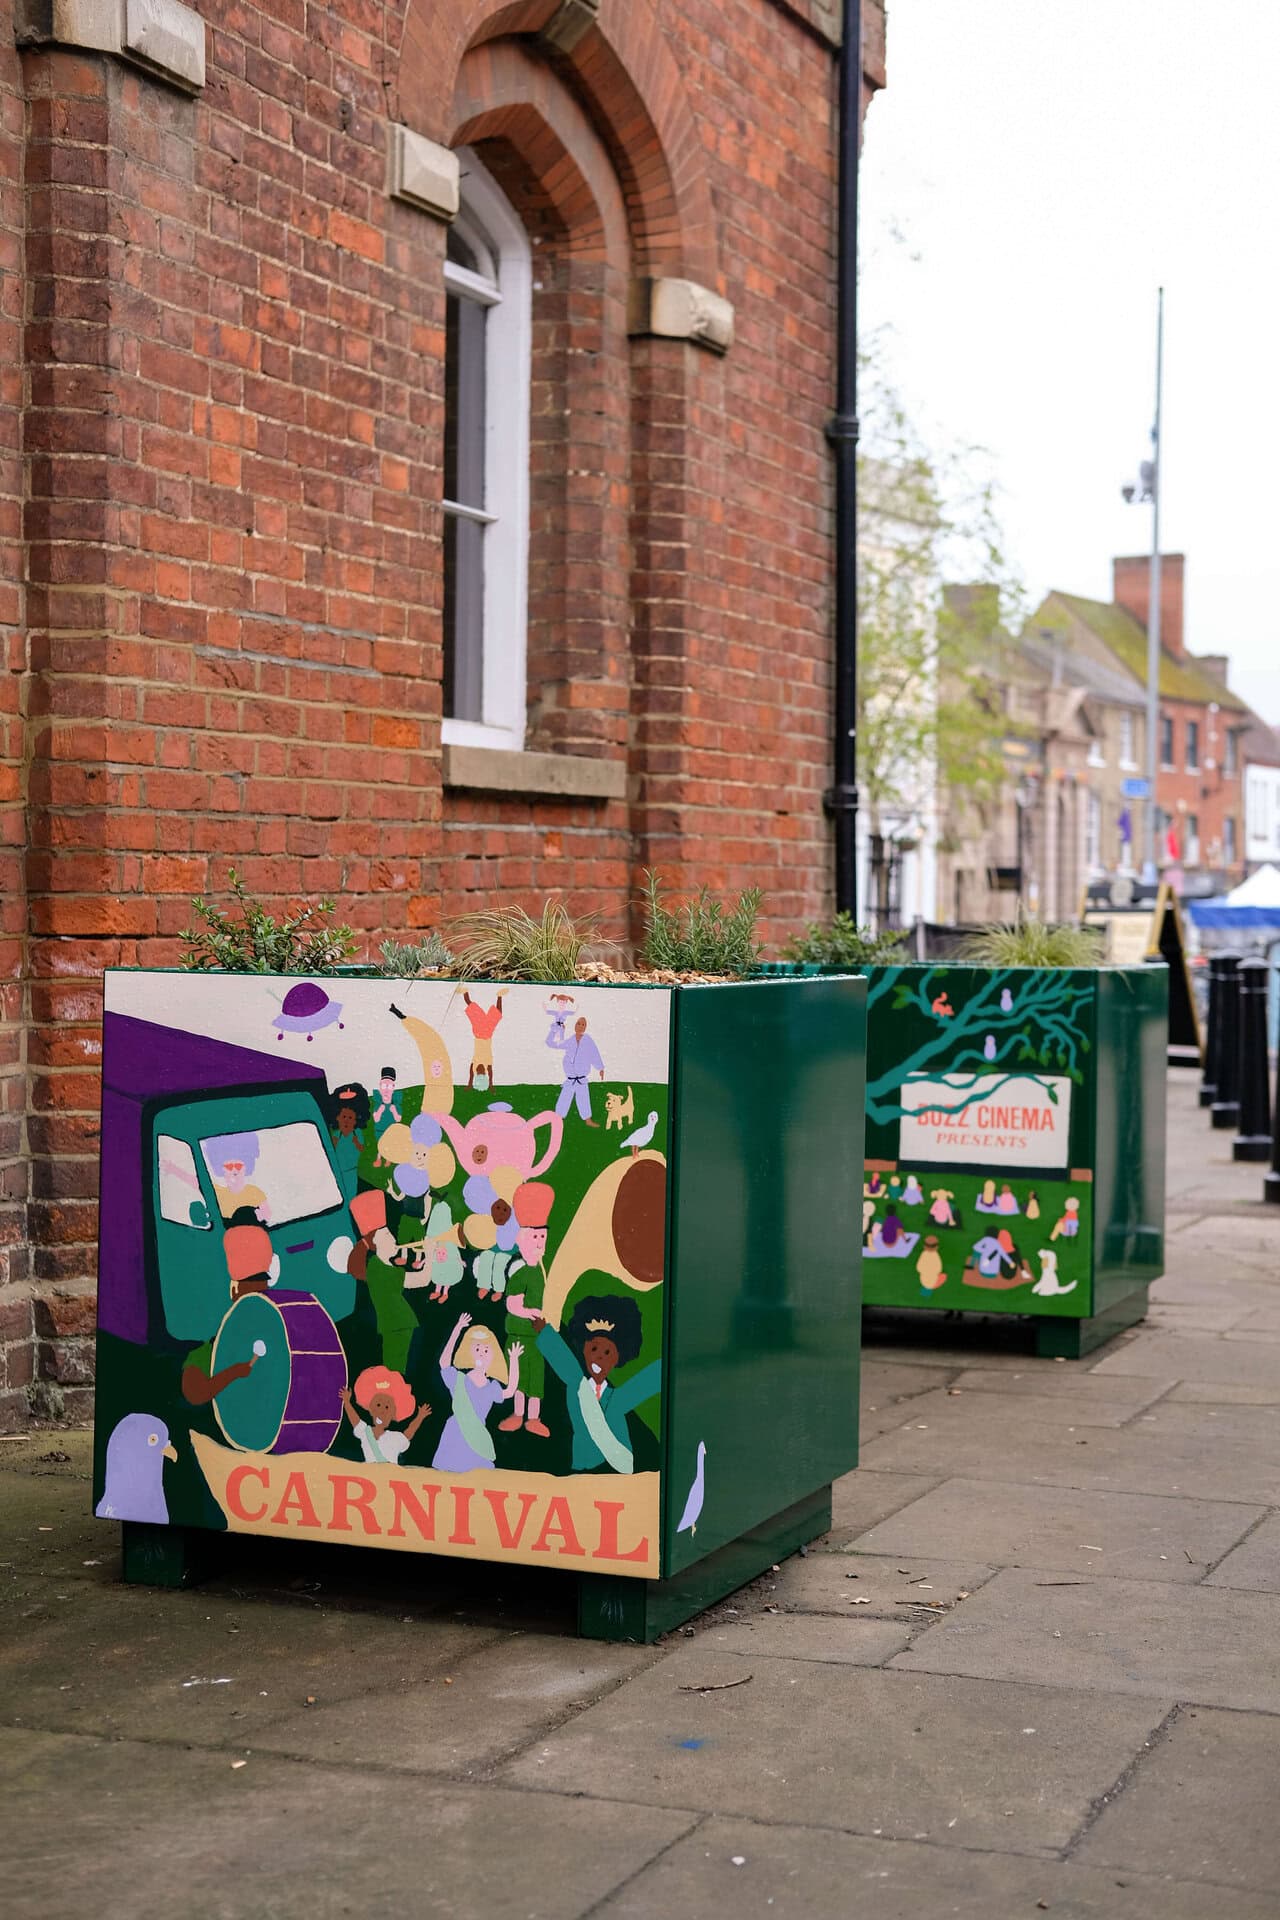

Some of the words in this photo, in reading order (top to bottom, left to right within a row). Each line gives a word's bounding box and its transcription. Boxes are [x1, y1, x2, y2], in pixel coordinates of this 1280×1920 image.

[977, 1105, 1055, 1131] CINEMA
[936, 1132, 1027, 1149] PRESENTS
[225, 1465, 649, 1562] CARNIVAL
